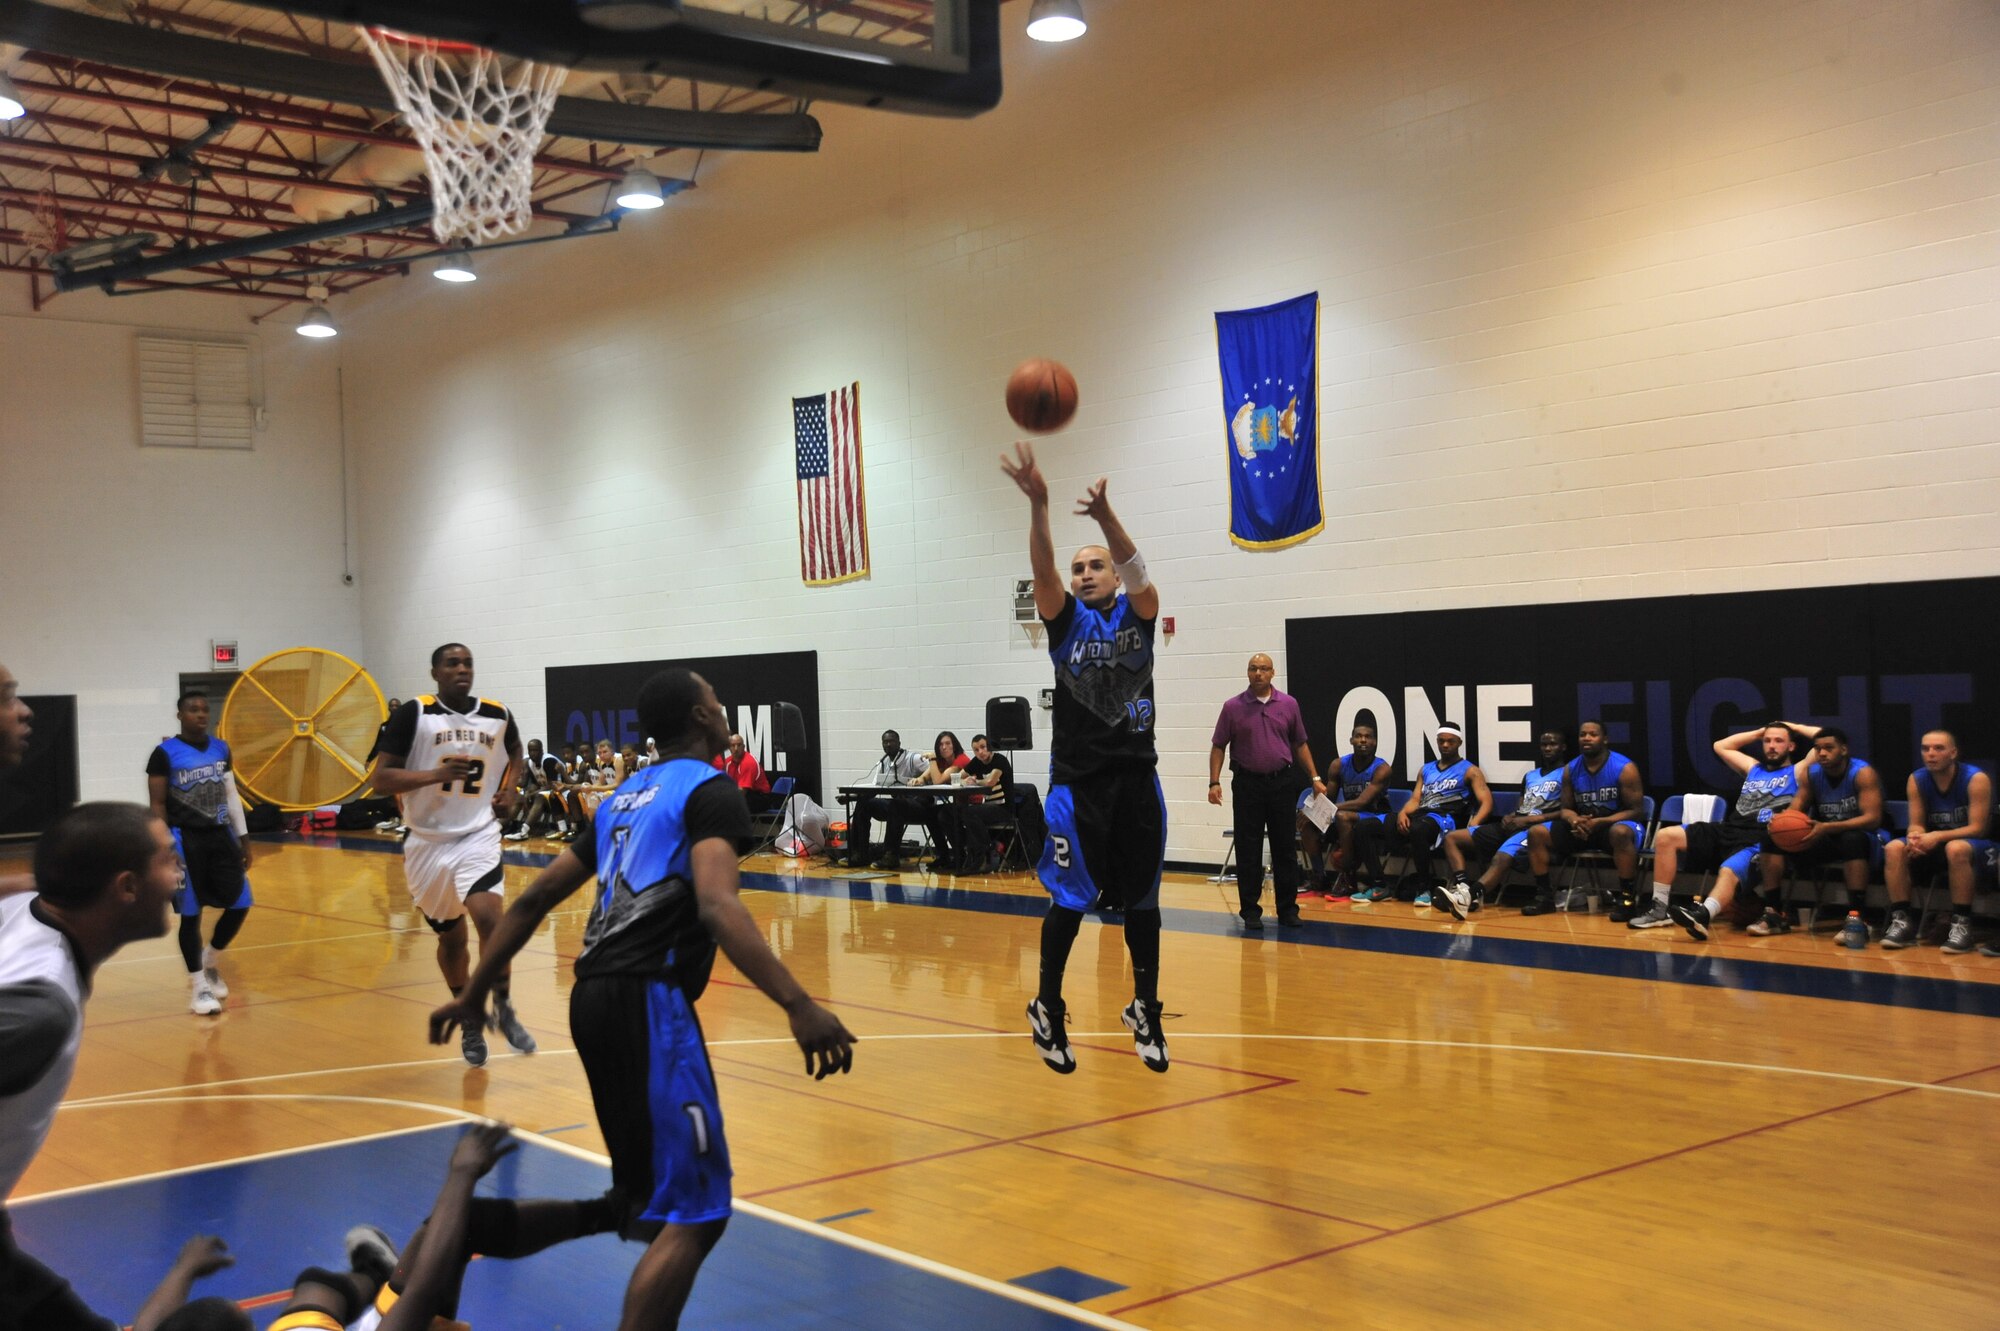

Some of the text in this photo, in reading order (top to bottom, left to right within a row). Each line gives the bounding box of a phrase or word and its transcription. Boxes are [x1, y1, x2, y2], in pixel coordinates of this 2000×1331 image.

[1115, 626, 1142, 655] AFB
[566, 708, 640, 752] ONE
[1123, 698, 1154, 733] 12
[435, 730, 453, 746] BIG
[456, 729, 476, 742] RED
[1334, 683, 1536, 785] ONE
[178, 765, 214, 785] WHITEMAN
[1543, 781, 1558, 793] AFB
[1599, 787, 1618, 802] AFB
[684, 1102, 709, 1155] 1
